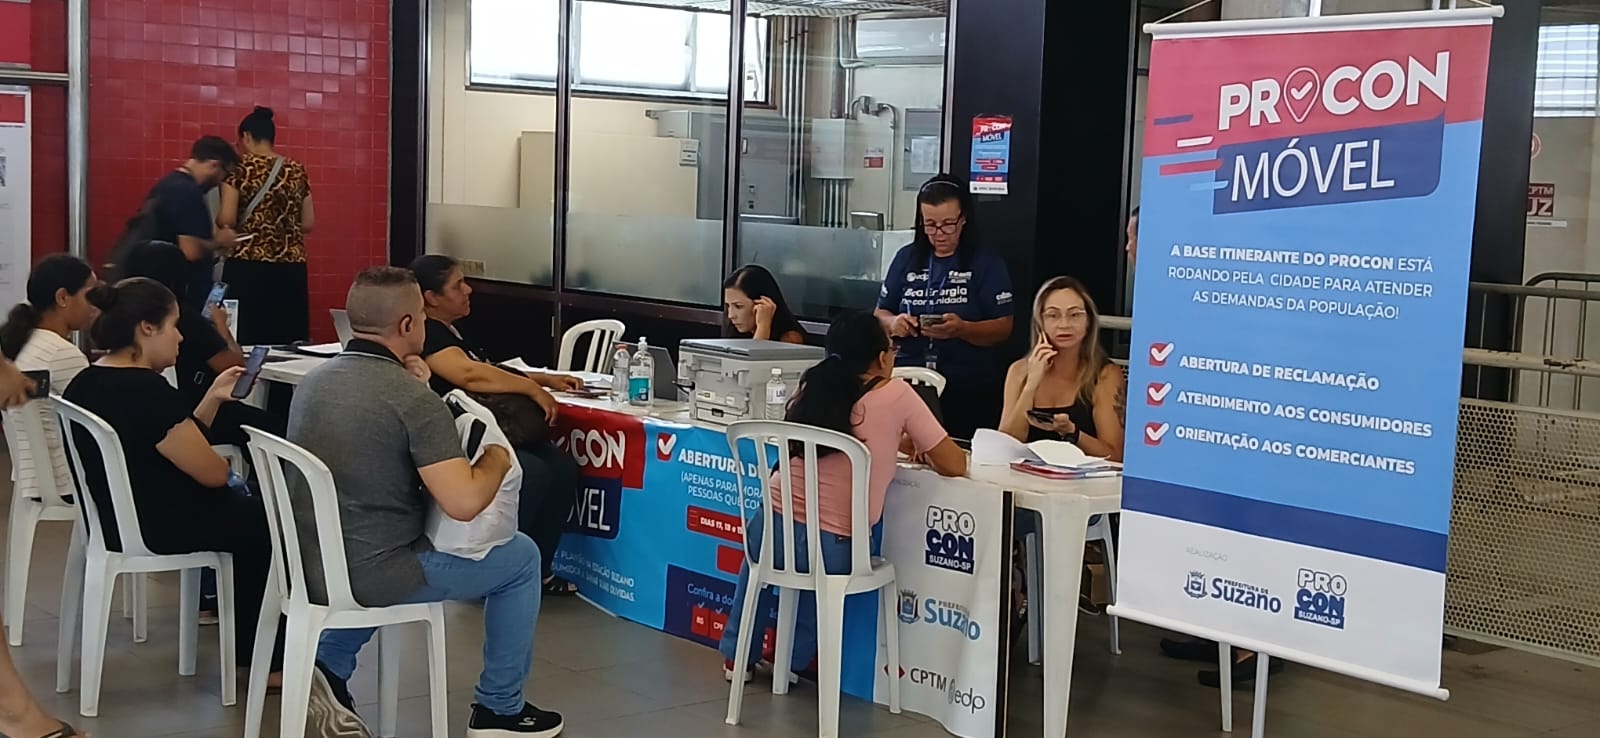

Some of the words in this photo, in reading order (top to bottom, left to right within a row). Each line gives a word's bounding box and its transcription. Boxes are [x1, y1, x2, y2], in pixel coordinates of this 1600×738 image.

[1218, 51, 1450, 131] PROCON
[1231, 138, 1395, 201] MÓVEL
[1170, 244, 1181, 257] A
[1183, 245, 1217, 259] BASE
[1220, 247, 1300, 265] ITINERANTE
[1303, 252, 1326, 266] DO
[1329, 254, 1394, 270] PROCON
[1398, 256, 1433, 272] ESTÁ
[1168, 266, 1230, 282] RODANDO
[1232, 271, 1264, 285] PELA
[1270, 274, 1321, 289] CIDADE
[1324, 277, 1361, 291] PARA
[1365, 280, 1433, 297] ATENDER
[1192, 290, 1209, 303] AS
[1211, 292, 1283, 309] DEMANDAS
[1286, 298, 1305, 311] DA
[1309, 300, 1399, 320] POPULAÇÃO!
[1179, 355, 1249, 375] ABERTURA
[1252, 364, 1272, 378] DE
[1274, 366, 1380, 391] RECLAMAÇÃO
[1177, 390, 1271, 415] ATENDIMENTO
[1274, 404, 1305, 419] AOS
[1309, 408, 1432, 437] CONSUMIDORES
[567, 428, 626, 470] CON
[678, 448, 745, 476] ABERTURA
[748, 462, 759, 478] D
[1175, 426, 1259, 450] ORIENTAÇÃO
[1261, 439, 1292, 455] AOS
[1295, 444, 1415, 474] COMERCIANTES
[681, 471, 714, 488] (APENAS
[715, 479, 738, 493] PARA
[688, 485, 723, 502] PESSOAS
[567, 488, 611, 531] VEL
[700, 517, 715, 528] DIAS
[926, 505, 976, 536] PRO
[926, 529, 975, 561] CON
[929, 555, 972, 571] SUZANO-SP
[687, 583, 714, 600] Confira
[722, 594, 734, 606] do
[1210, 578, 1282, 613] Suzano
[1224, 579, 1259, 593] PREFEITURA
[1297, 568, 1348, 596] PRO
[1296, 588, 1346, 617] CON
[1298, 610, 1341, 626] SUZANO-SP
[910, 668, 947, 692] CPTM
[954, 687, 986, 714] edp
